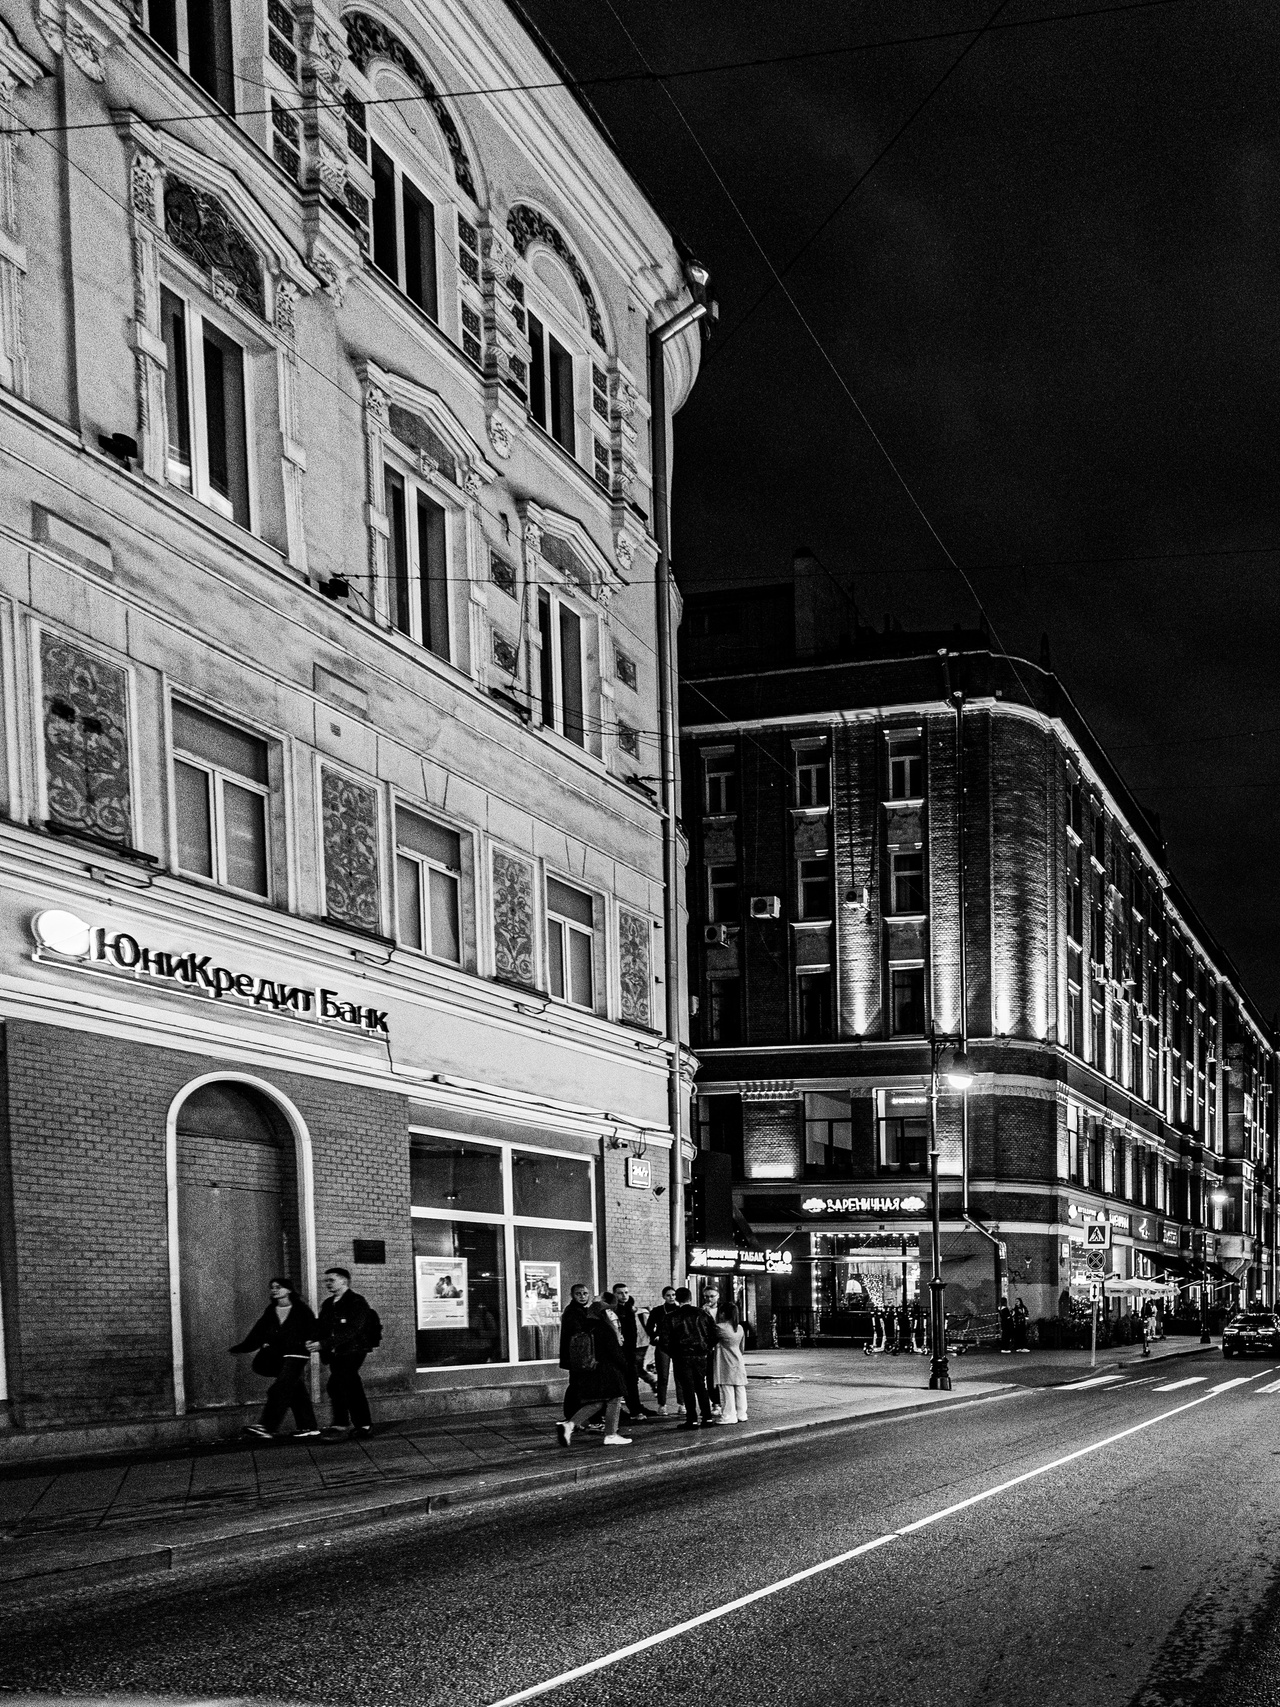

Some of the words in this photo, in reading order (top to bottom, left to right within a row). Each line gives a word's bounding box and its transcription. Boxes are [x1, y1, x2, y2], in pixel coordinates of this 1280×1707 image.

[90, 927, 314, 1012] ЮниКредит
[317, 986, 389, 1033] Банк
[826, 1197, 900, 1212] ВАРЕНИЧНАЯ
[740, 1250, 765, 1262] ТАБАК
